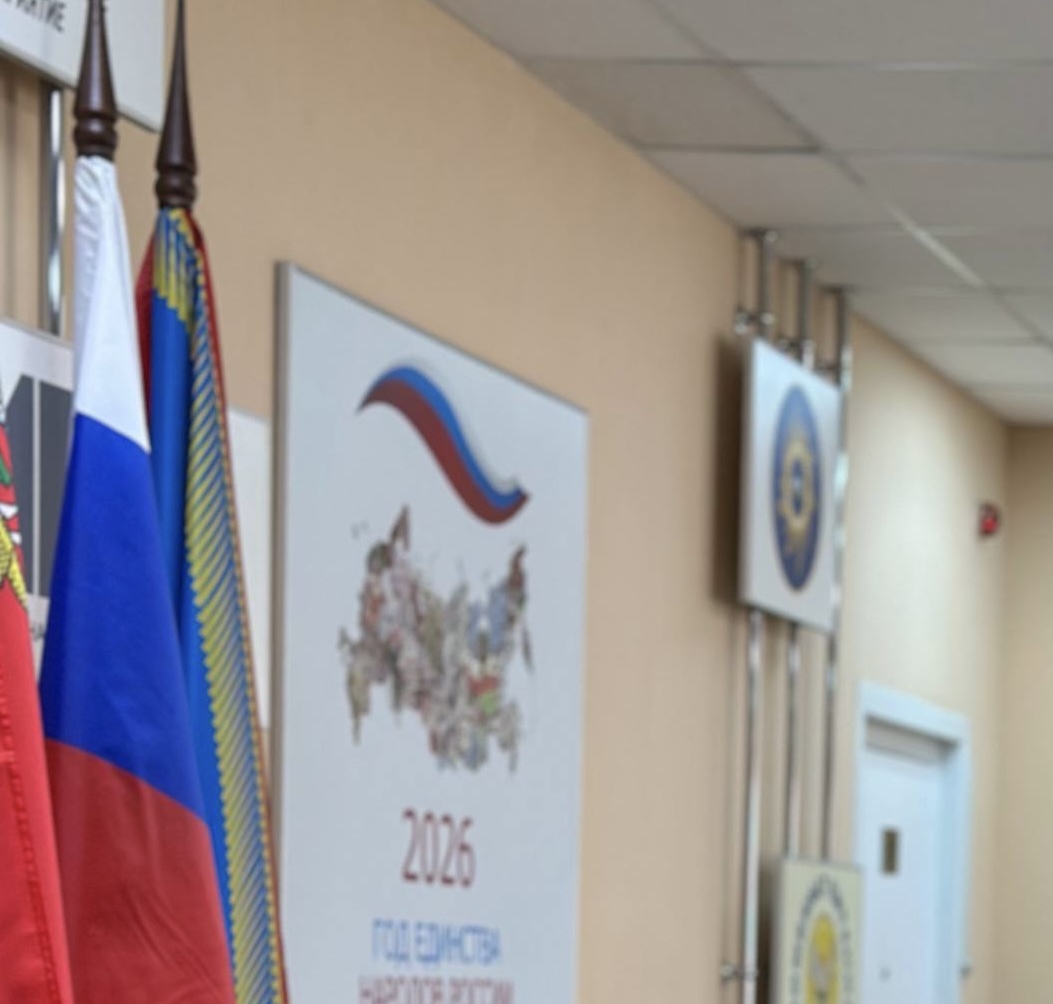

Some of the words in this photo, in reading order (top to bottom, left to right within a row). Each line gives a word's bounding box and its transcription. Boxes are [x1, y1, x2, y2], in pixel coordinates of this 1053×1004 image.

[401, 808, 476, 889] 2026
[371, 916, 410, 966] ГОД
[415, 919, 503, 967] ЕДИНСТВА
